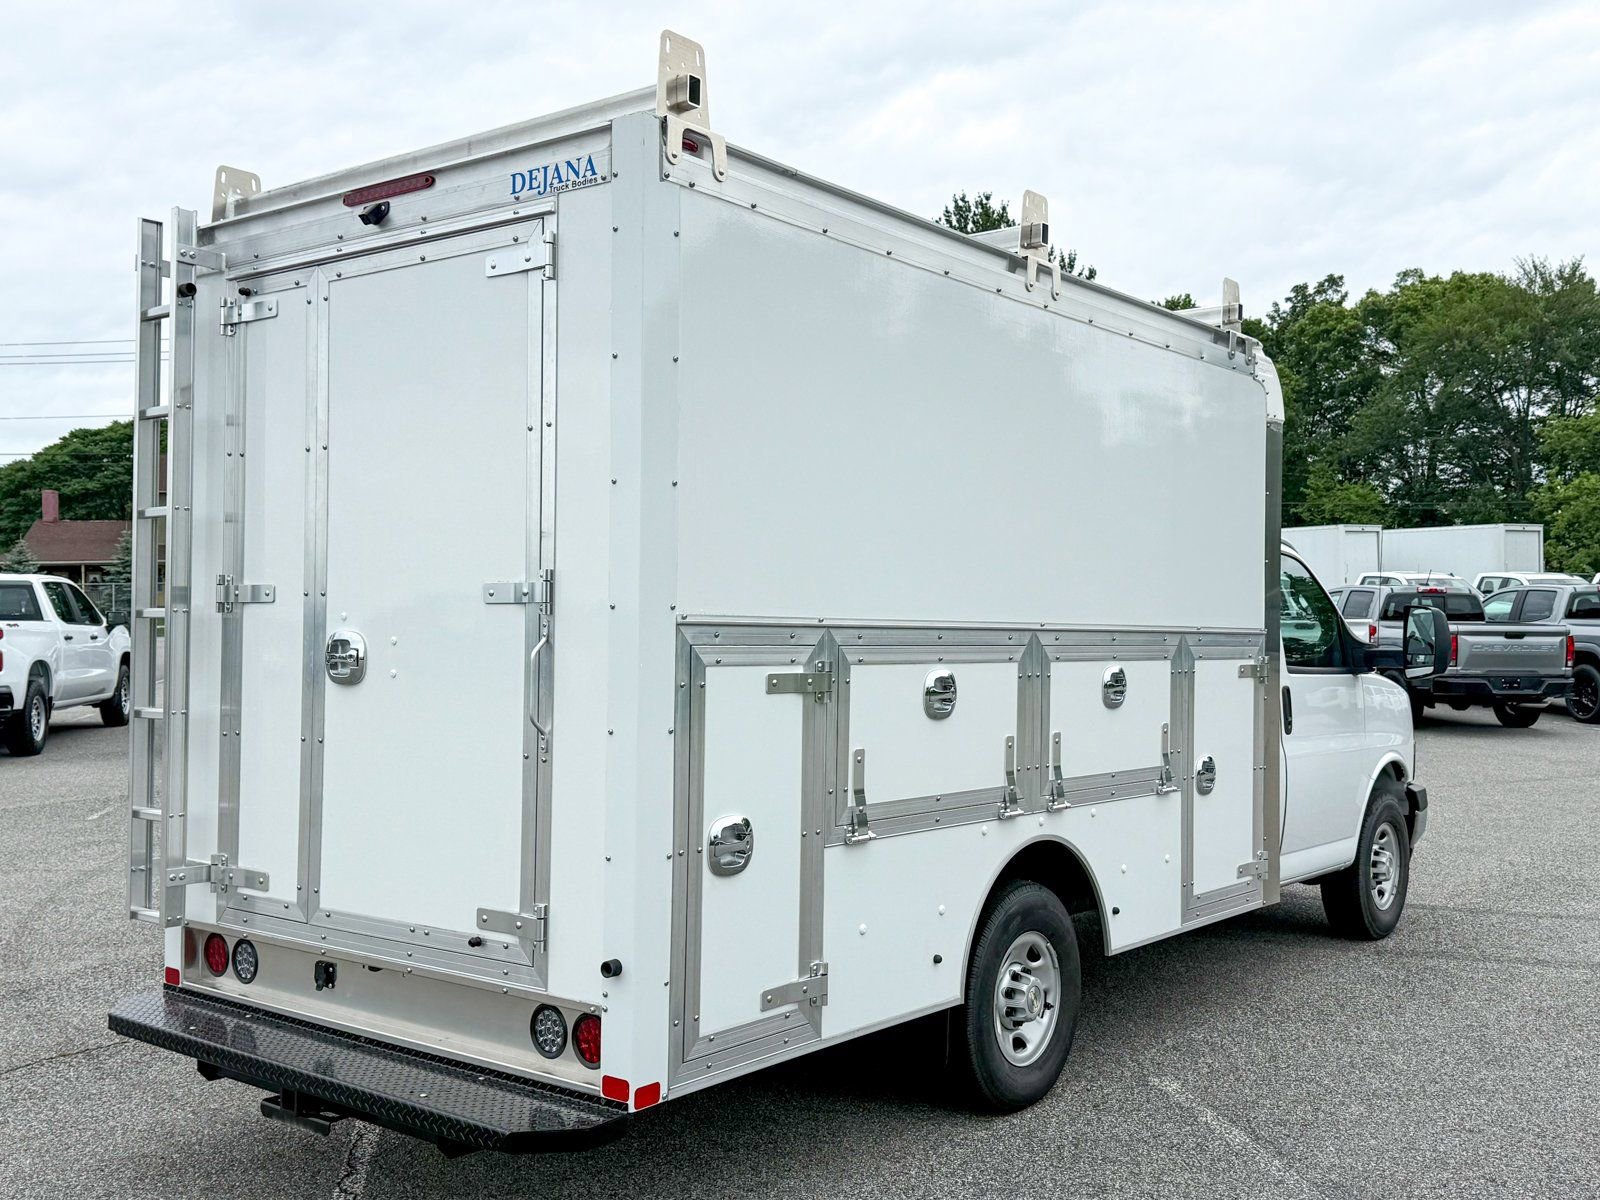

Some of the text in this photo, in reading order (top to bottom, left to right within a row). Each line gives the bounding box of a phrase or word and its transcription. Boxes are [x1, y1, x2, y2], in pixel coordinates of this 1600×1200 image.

[510, 154, 598, 196] DEJANA
[549, 176, 598, 194] Truck Bodies
[1471, 644, 1557, 653] CHEVROLET
